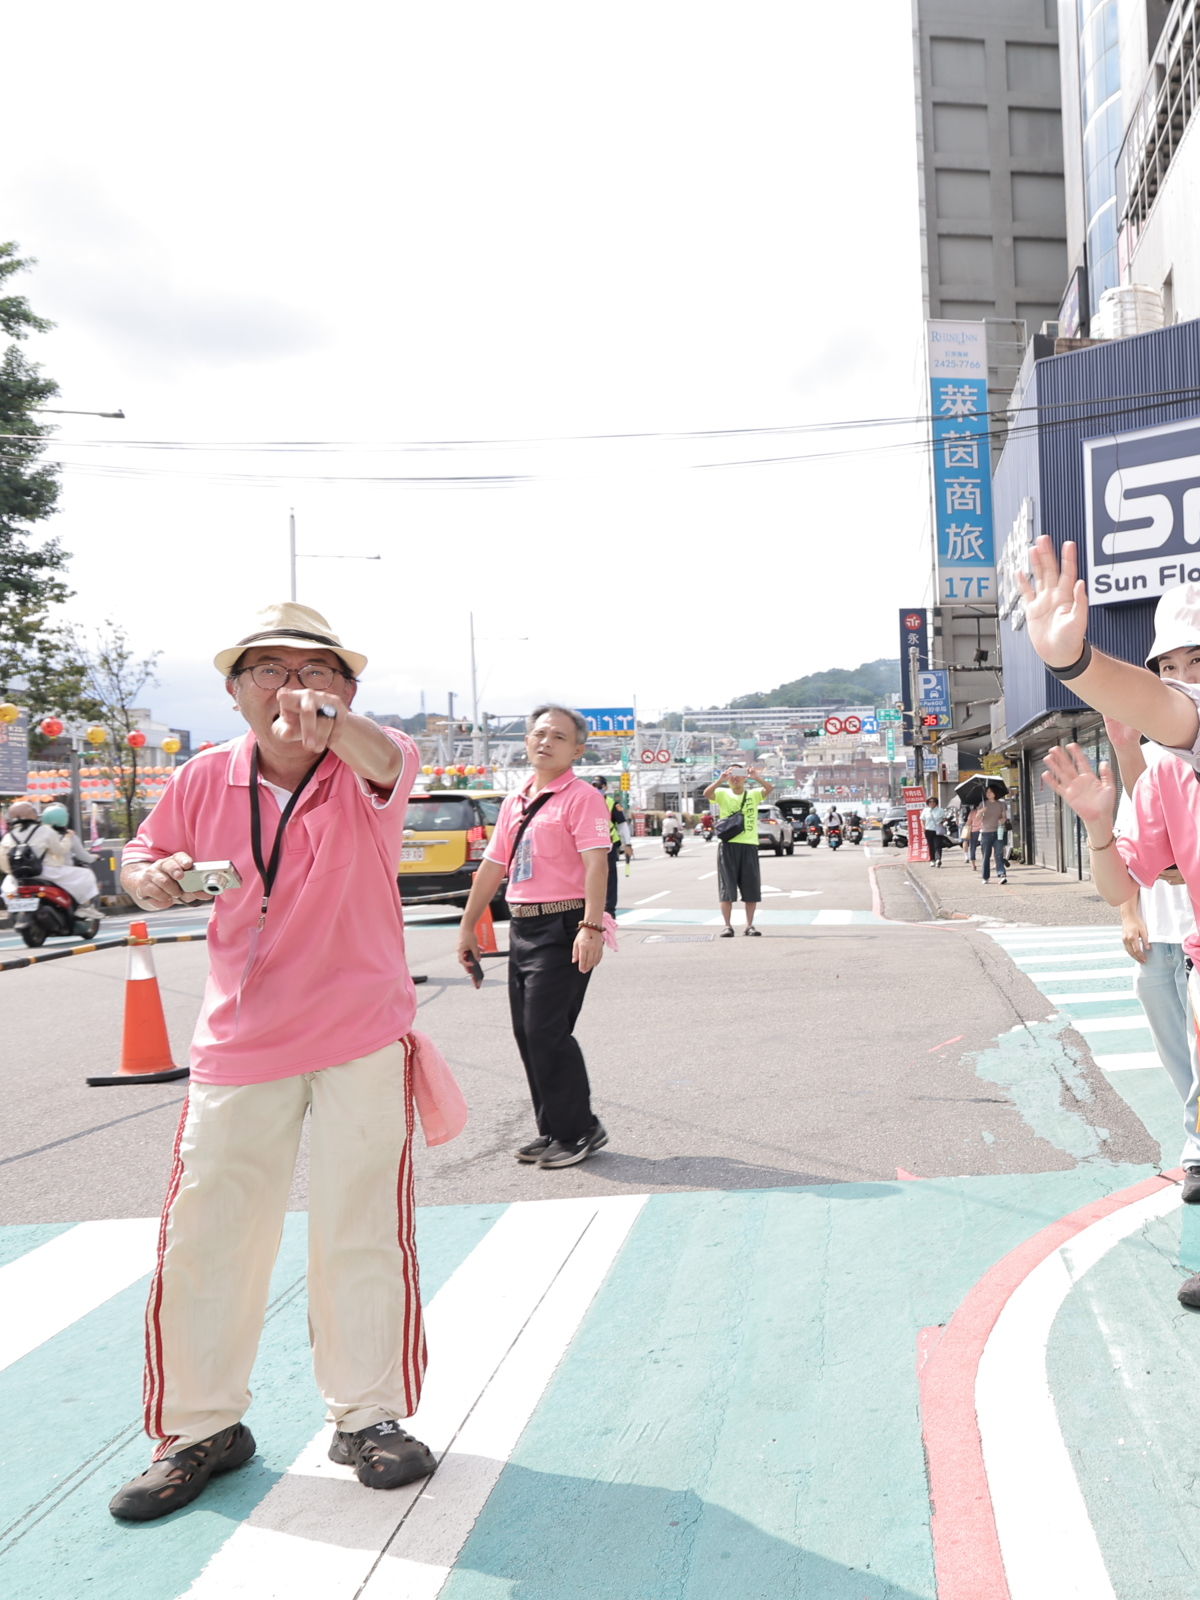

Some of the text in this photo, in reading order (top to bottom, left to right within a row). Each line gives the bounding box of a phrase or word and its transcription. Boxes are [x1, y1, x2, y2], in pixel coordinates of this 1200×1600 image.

[938, 384, 986, 561] 萊茵商旅
[945, 576, 990, 600] 17F
[1094, 573, 1147, 594] Sun
[924, 714, 937, 726] 36
